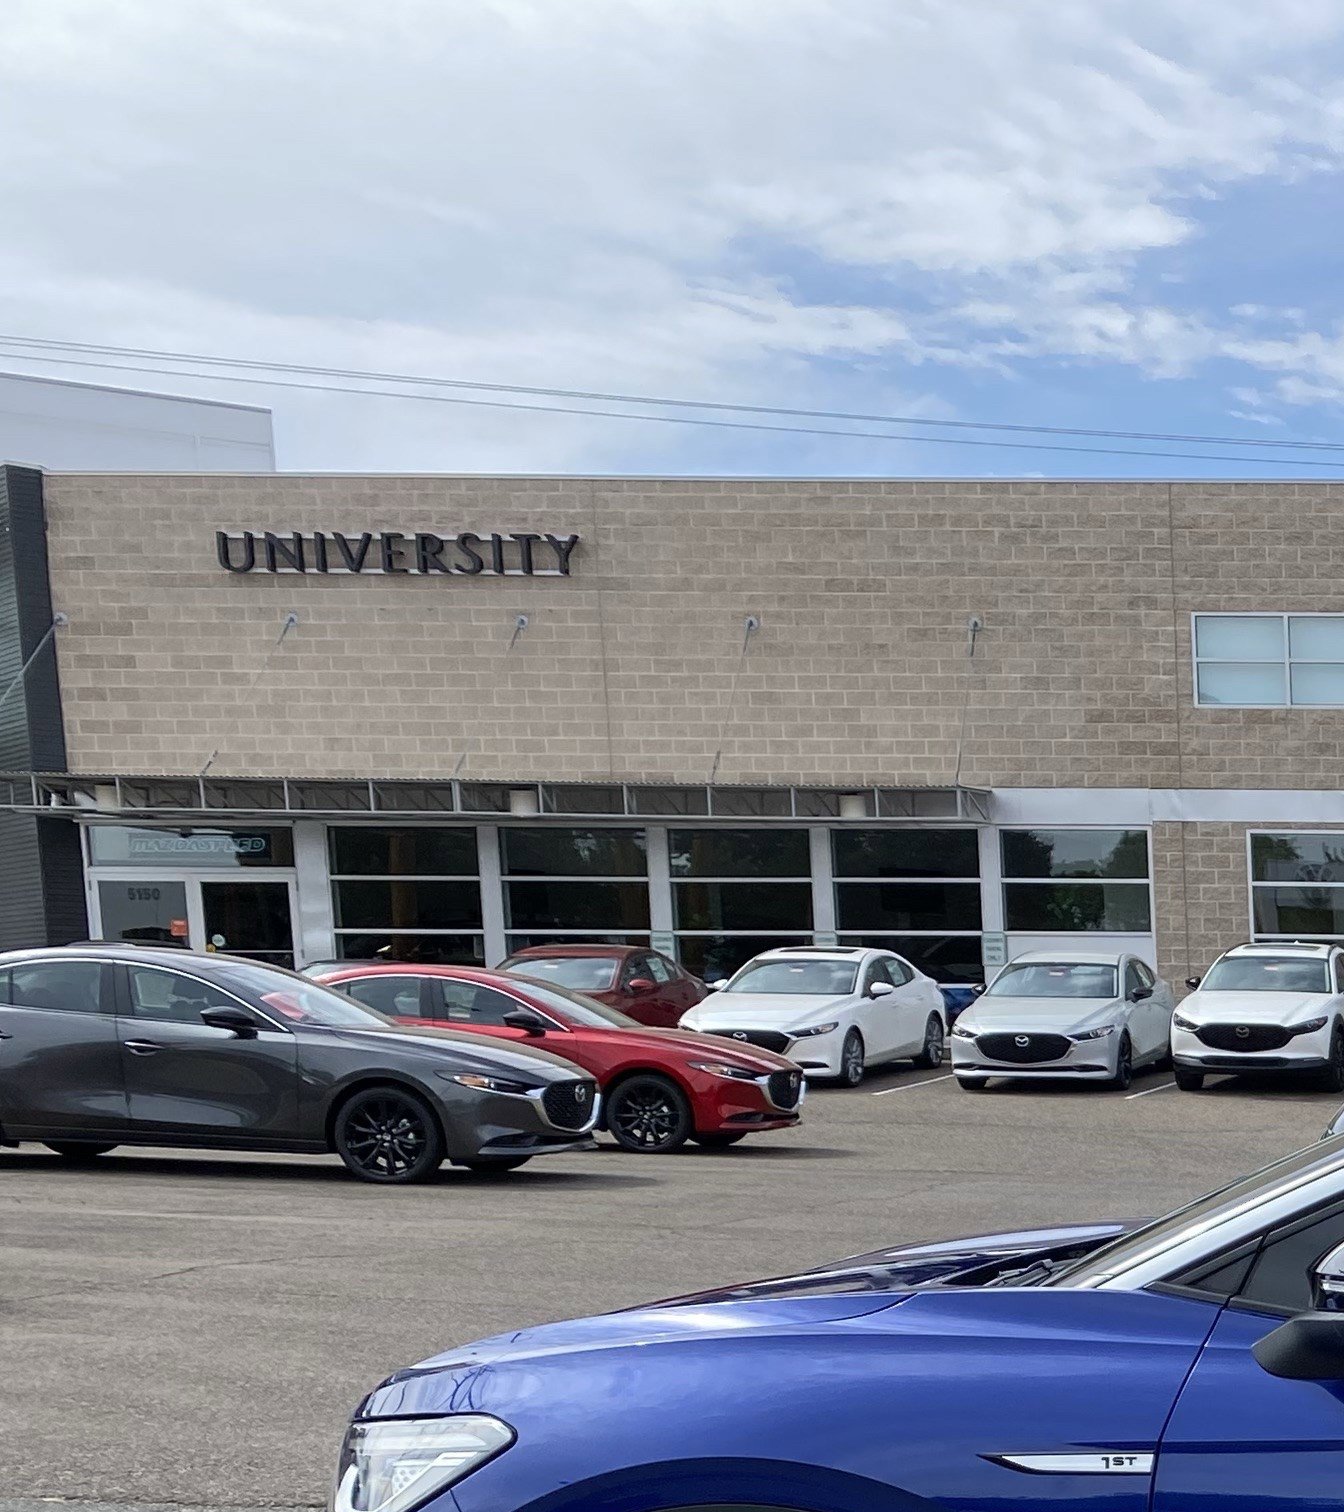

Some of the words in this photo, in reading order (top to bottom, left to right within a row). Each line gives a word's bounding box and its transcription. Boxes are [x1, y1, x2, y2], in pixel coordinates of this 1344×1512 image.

[216, 531, 580, 576] UNIVERSITY
[127, 887, 161, 901] 5150
[1101, 1456, 1137, 1469] 1ST
